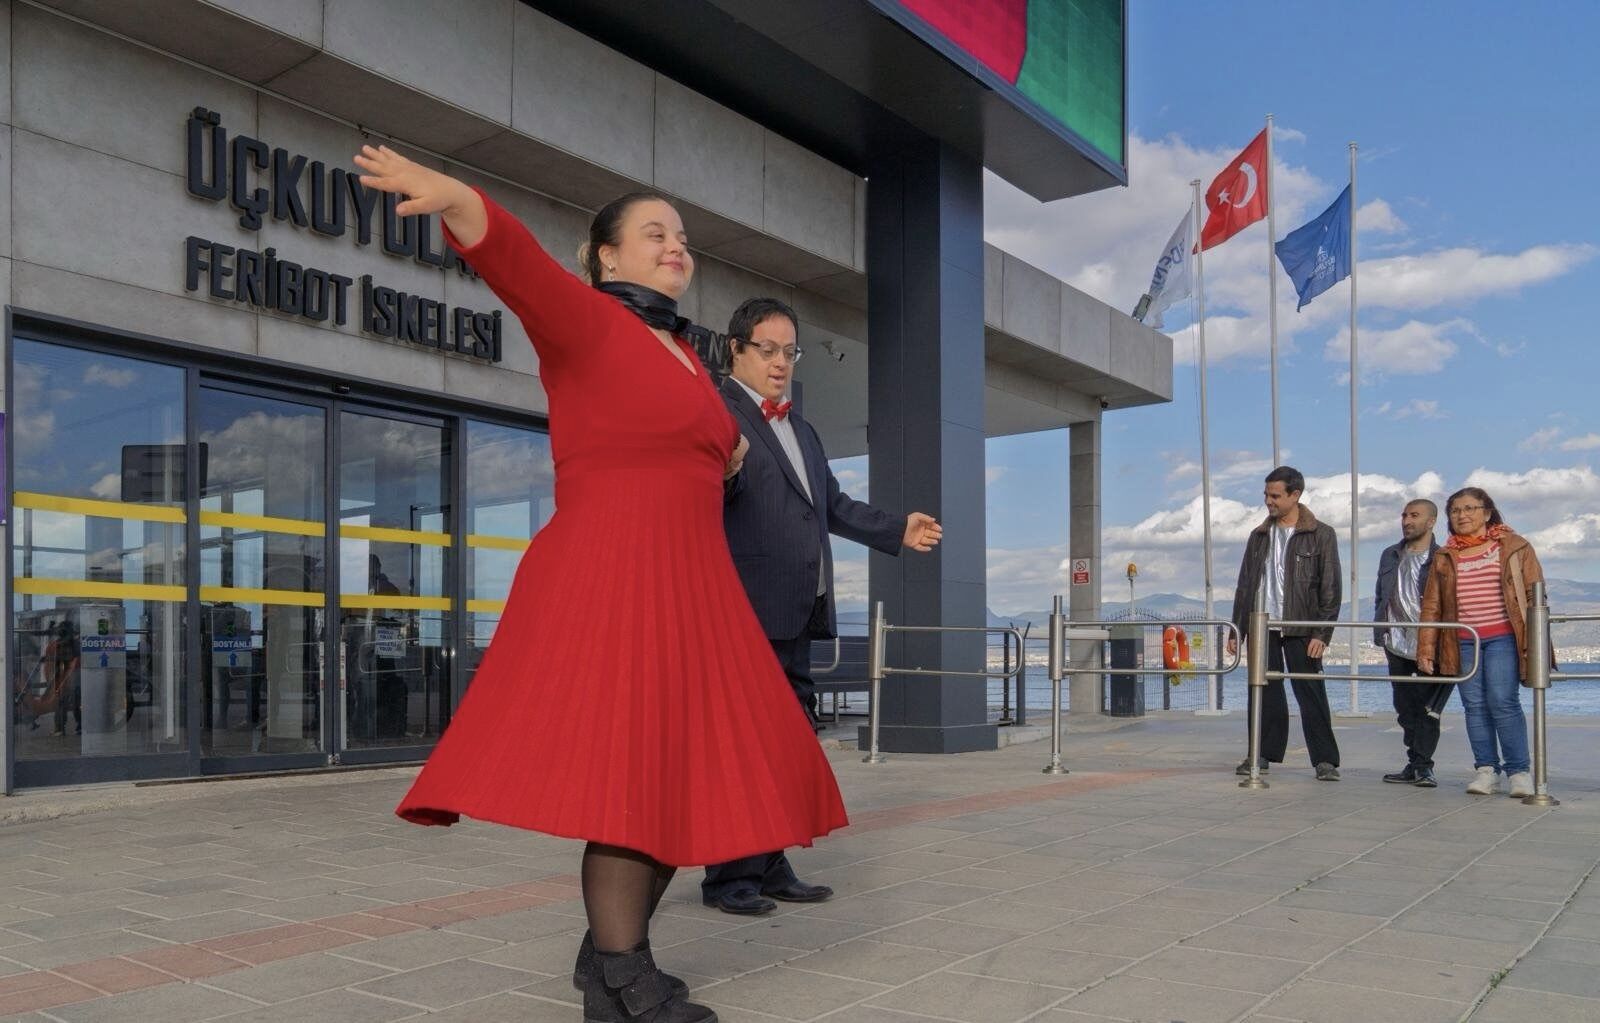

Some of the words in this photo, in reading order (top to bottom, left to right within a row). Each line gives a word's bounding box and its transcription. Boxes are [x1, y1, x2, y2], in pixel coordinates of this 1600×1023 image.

[187, 106, 481, 278] ÜÇKUYUL
[185, 236, 353, 327] FERİBOT
[360, 274, 502, 363] İSKELESİ
